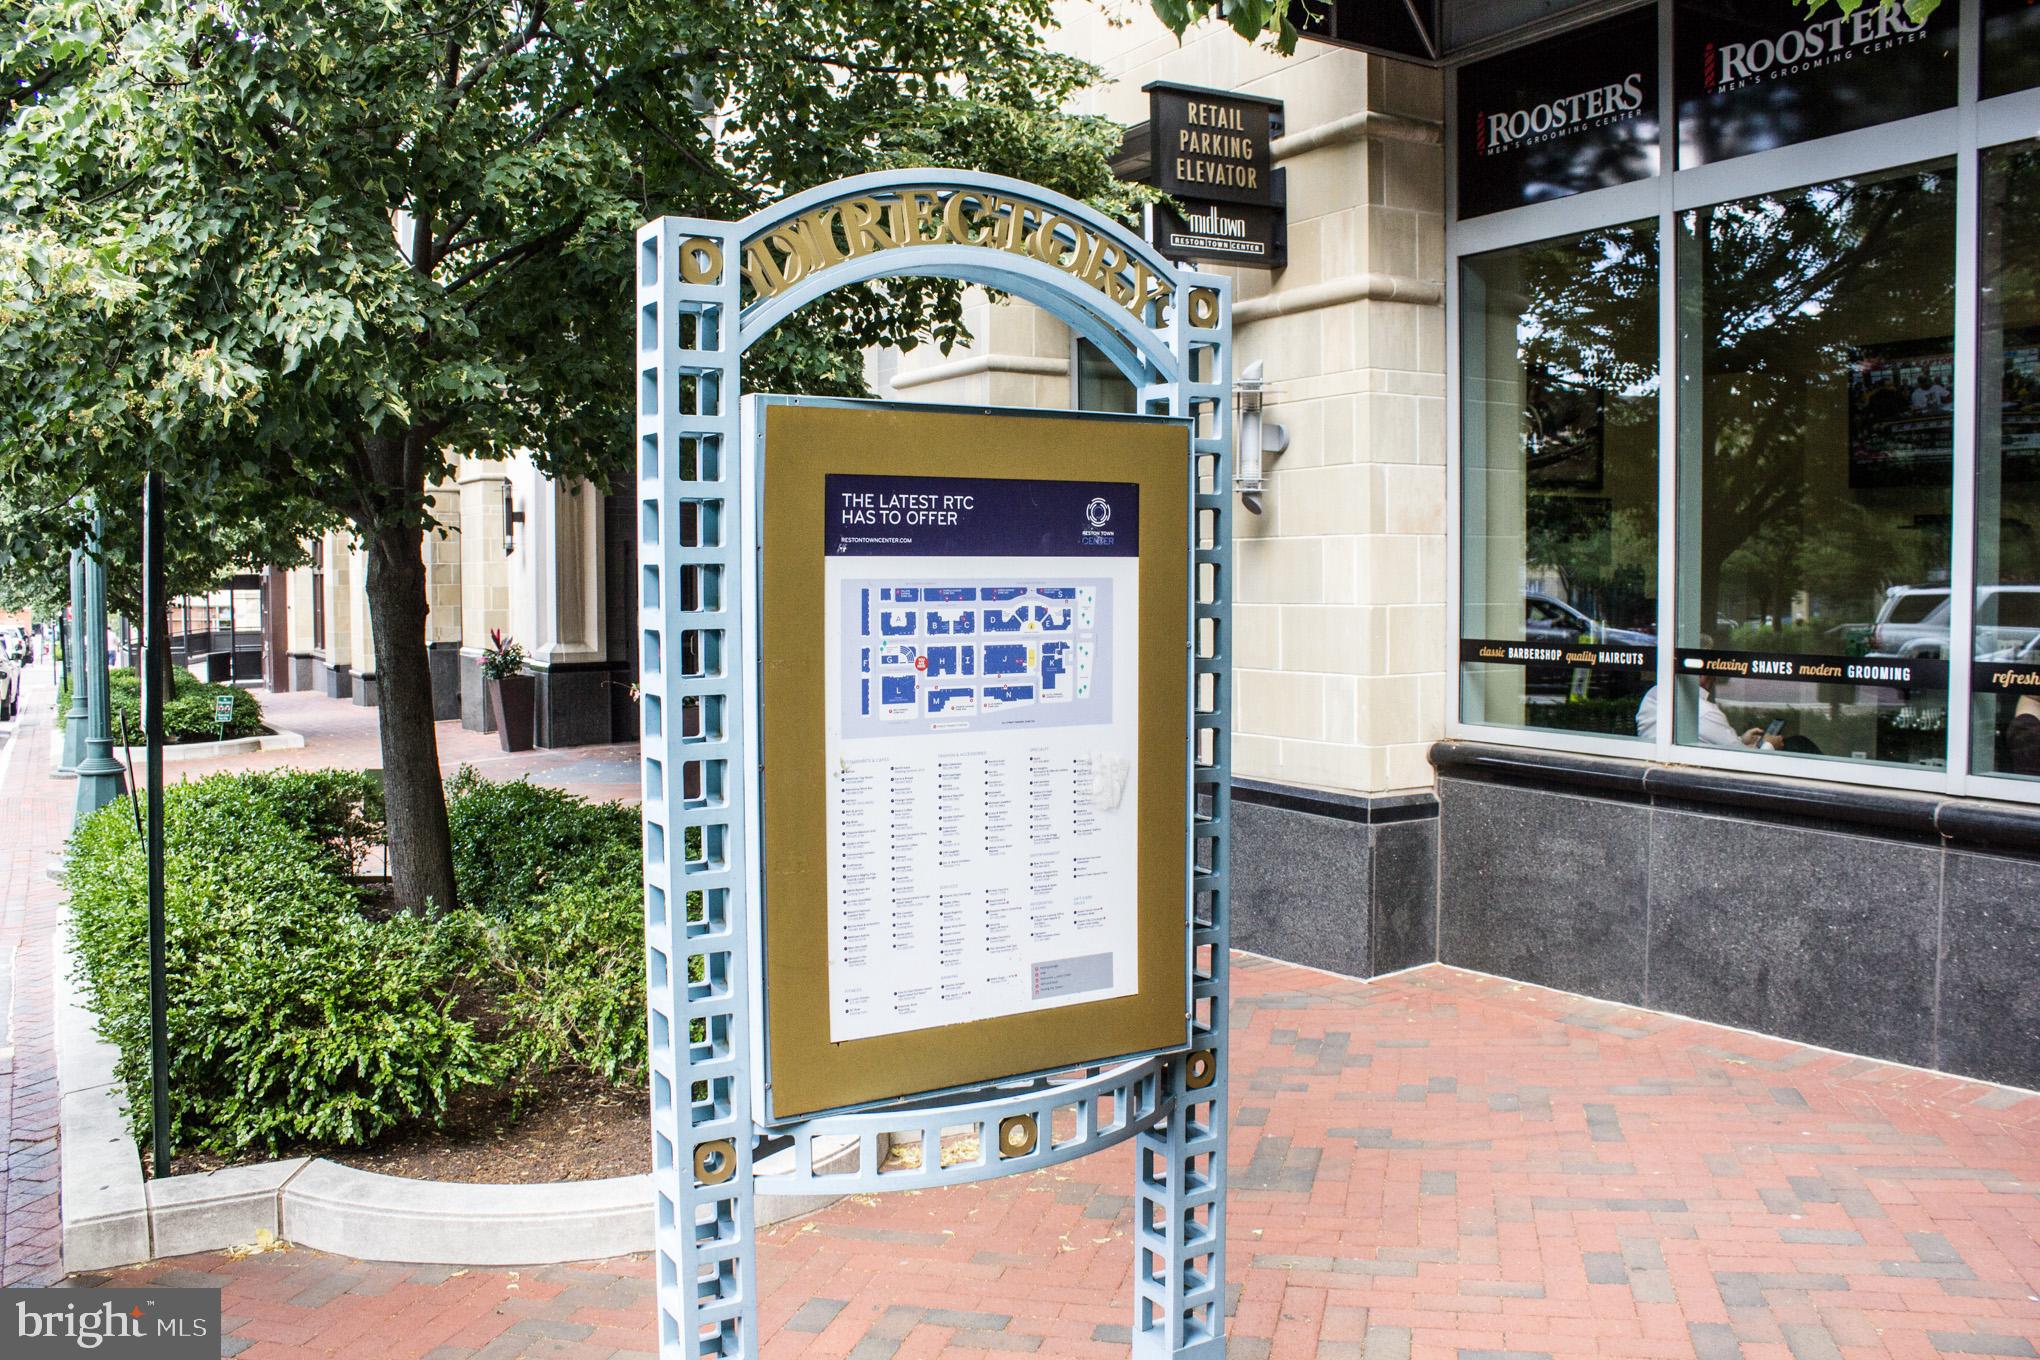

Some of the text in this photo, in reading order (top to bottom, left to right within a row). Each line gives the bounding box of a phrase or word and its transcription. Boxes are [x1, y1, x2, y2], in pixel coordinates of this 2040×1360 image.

[1718, 30, 1928, 94] MEN'S GROOMING CENTER
[1188, 102, 1244, 131] RETAIL
[1487, 73, 1643, 148] ROOSTERS
[1180, 130, 1253, 160] PARKING
[1487, 109, 1642, 156] MEN'S GROOMING CENTER
[1176, 158, 1257, 189] ELEVATOR
[1190, 206, 1246, 238] midtown
[743, 190, 1175, 322] DIRECTORY
[1174, 237, 1260, 252] RESTON TOWN CENTER
[842, 493, 974, 510] THE LATEST RTC
[842, 510, 958, 526] HAS TO OFFER
[1479, 646, 1644, 665] classic BARBERSHOP quality HAIRCUTS
[1706, 658, 1911, 681] relaxing SHAVES modern GROOMING
